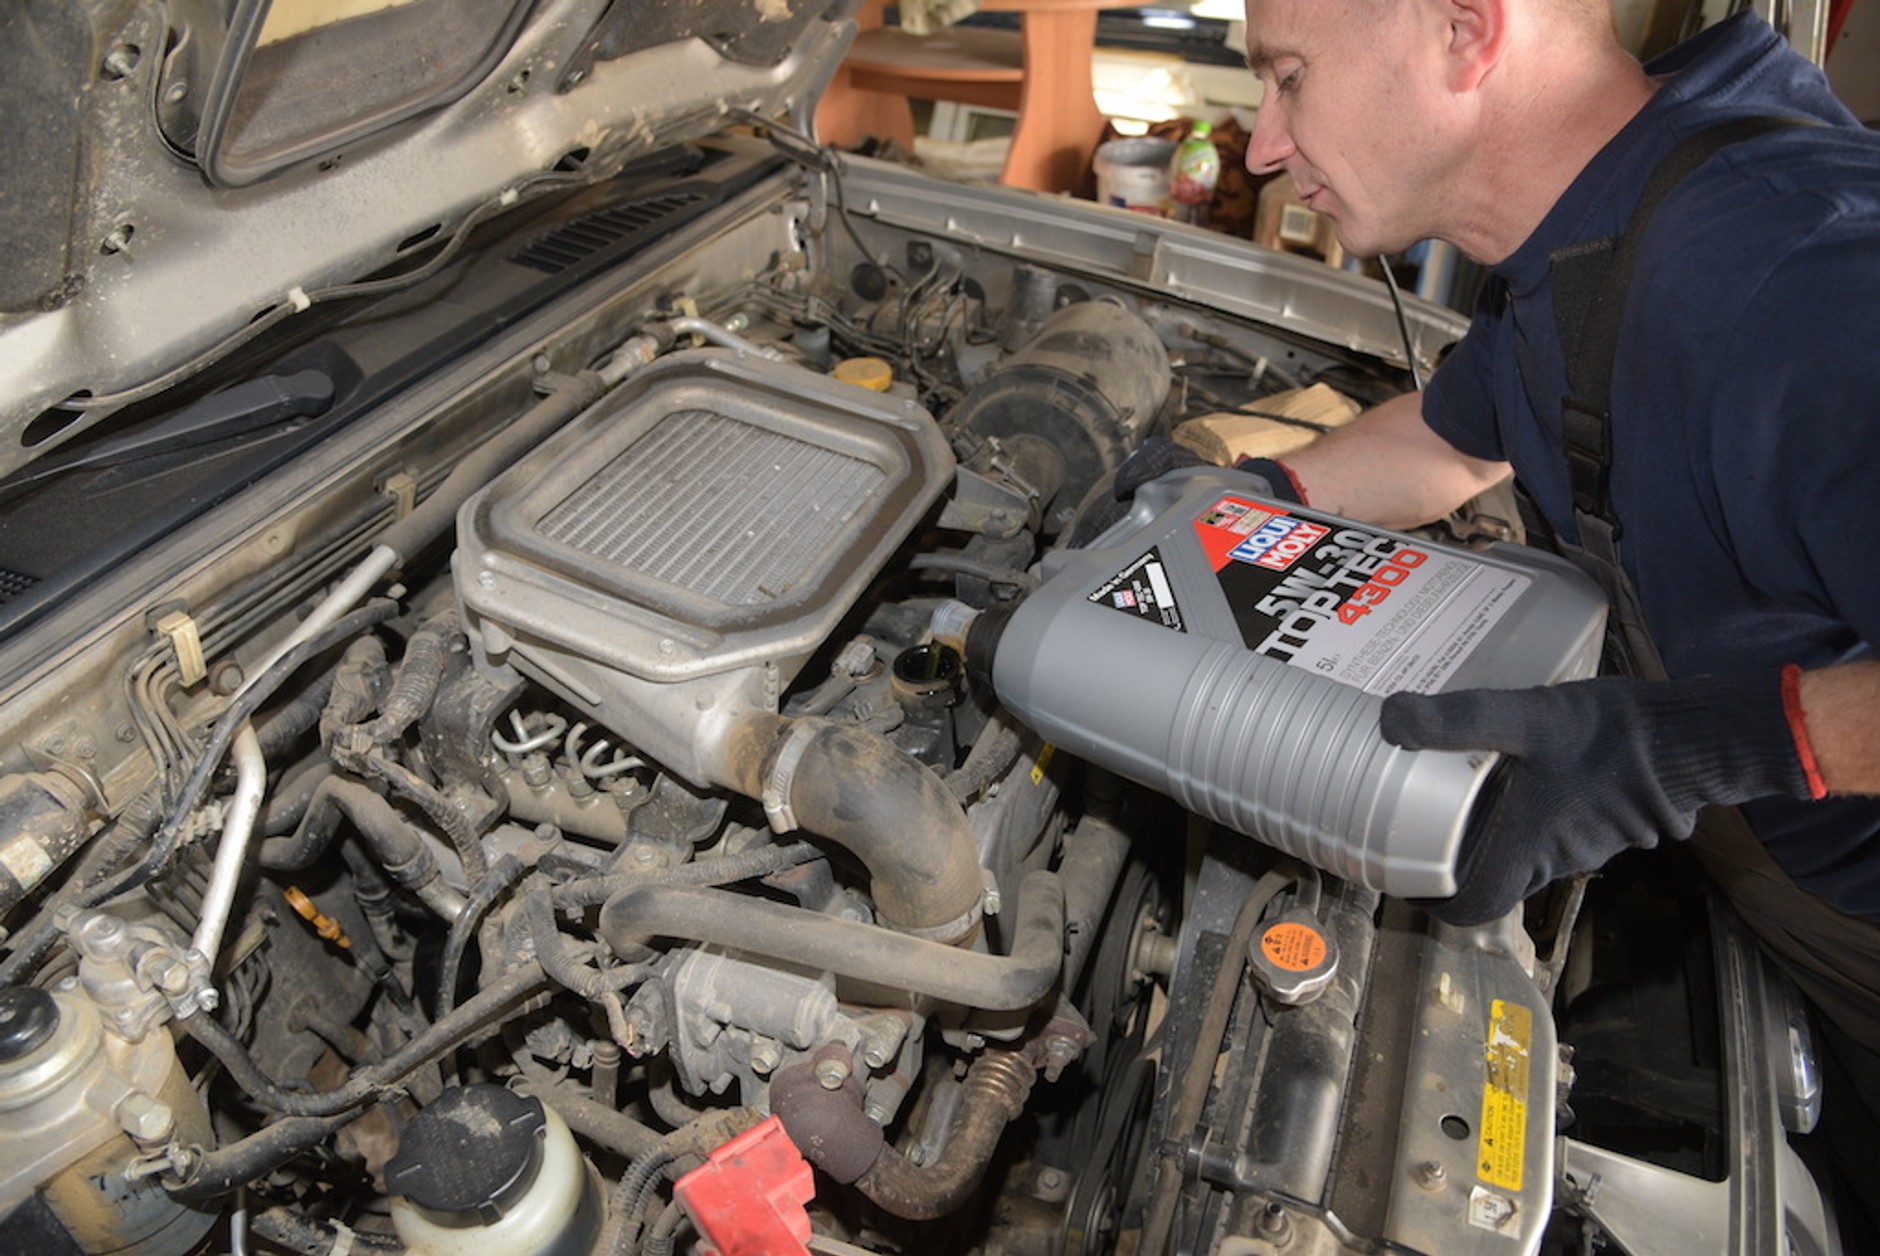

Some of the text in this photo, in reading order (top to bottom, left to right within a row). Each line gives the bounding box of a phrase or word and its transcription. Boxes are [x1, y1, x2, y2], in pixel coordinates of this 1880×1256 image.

[1233, 518, 1299, 560] LIQUI
[1254, 529, 1376, 621] 5W-30
[1261, 524, 1326, 567] MOLY
[1255, 536, 1405, 667] TOP TEC
[1336, 548, 1429, 626] 4300
